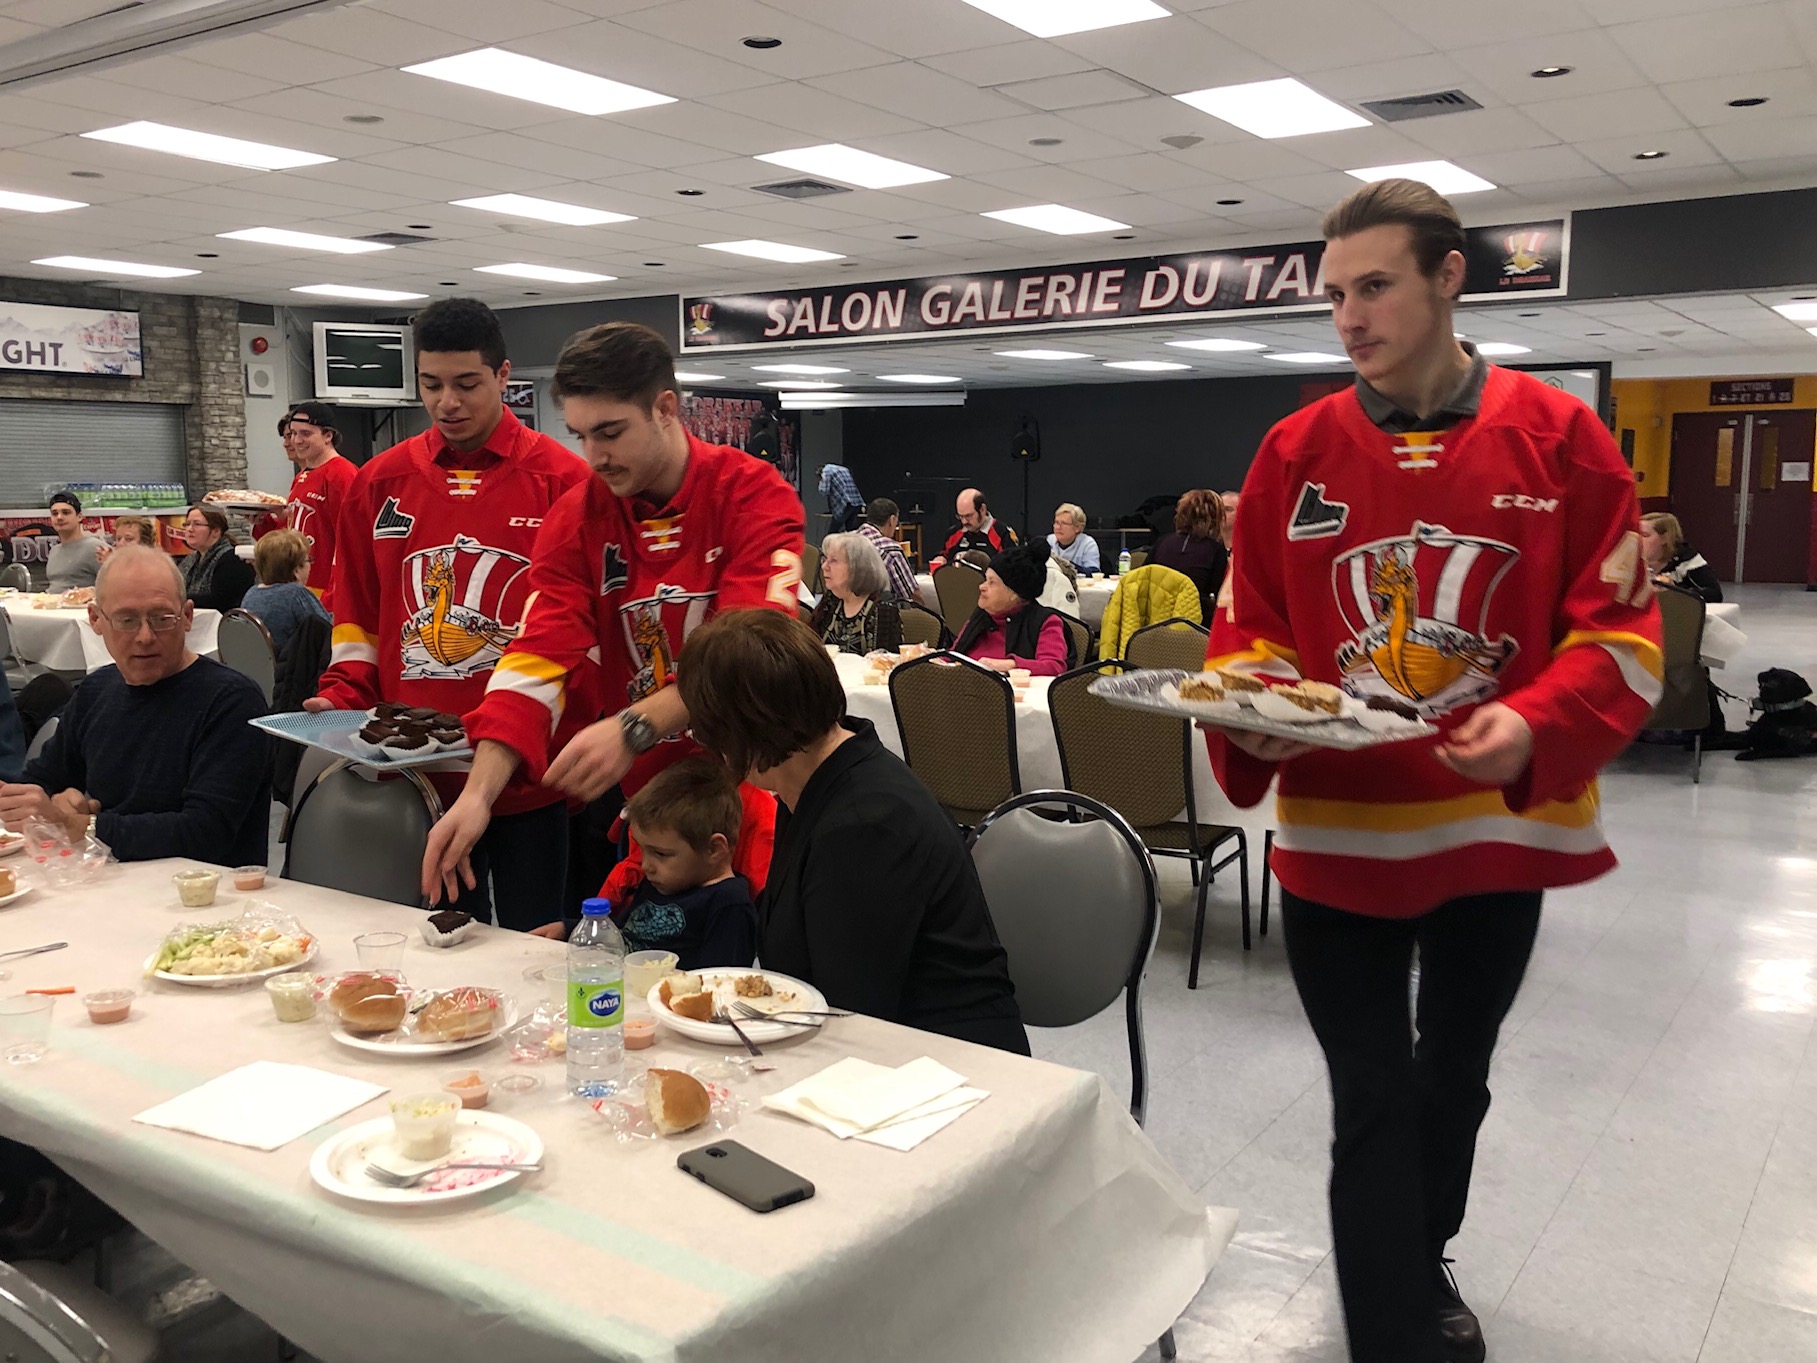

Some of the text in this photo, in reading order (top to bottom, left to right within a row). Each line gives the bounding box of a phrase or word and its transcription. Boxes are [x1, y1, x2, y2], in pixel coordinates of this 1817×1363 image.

[763, 288, 907, 337] SALON
[918, 267, 1126, 325] GALERIE
[1138, 257, 1224, 309] DU
[1490, 493, 1560, 513] CCM
[508, 516, 544, 528] CC
[592, 996, 620, 1011] NAYA
